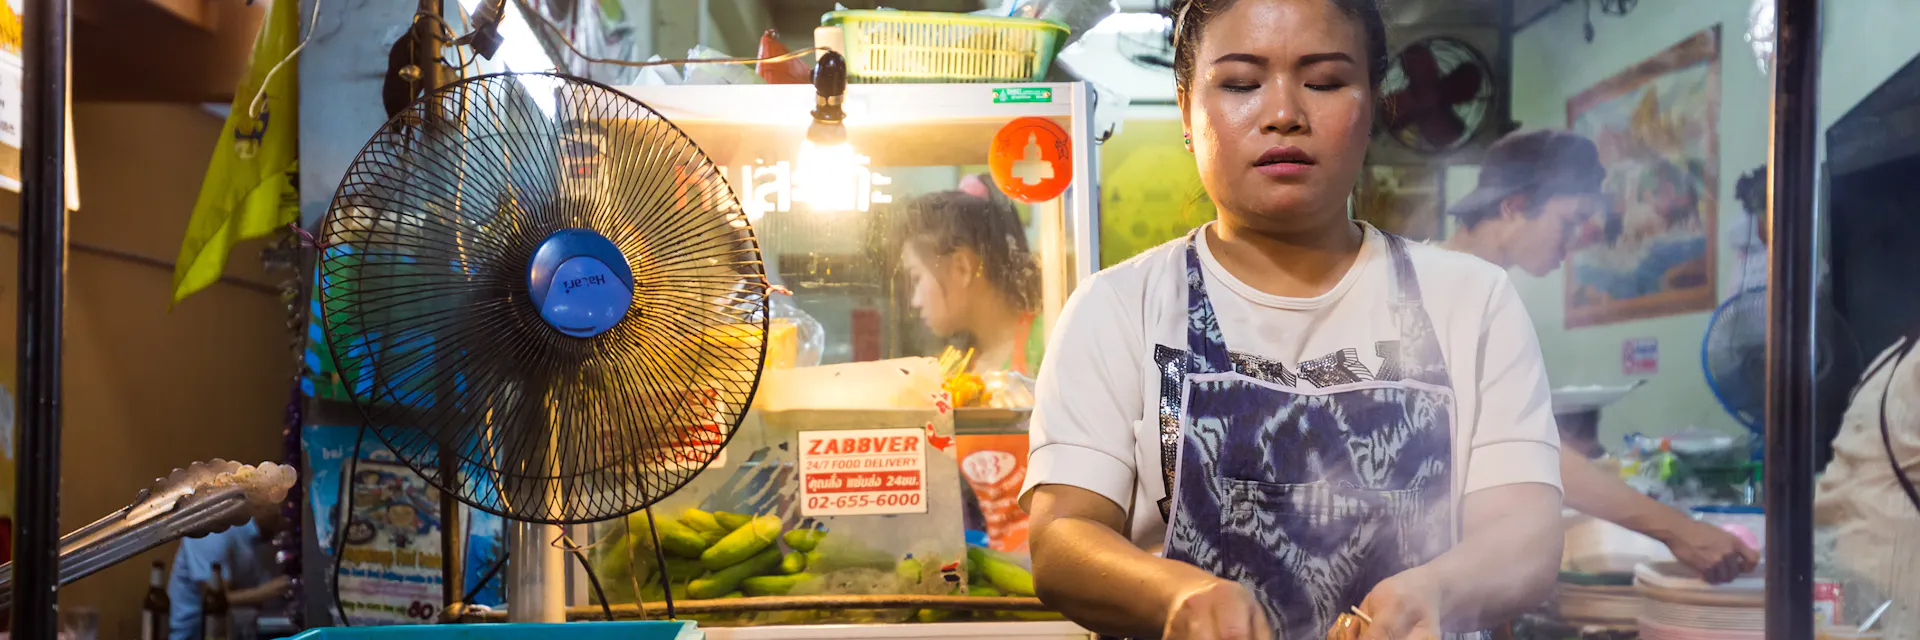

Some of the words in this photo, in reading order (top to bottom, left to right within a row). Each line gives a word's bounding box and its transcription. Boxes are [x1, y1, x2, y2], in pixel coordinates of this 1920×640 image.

[806, 435, 919, 456] ZABBVER
[806, 460, 829, 470] 24/7
[831, 458, 861, 469] FOOD
[864, 457, 918, 468] DELIVERY
[808, 493, 920, 509] 02-655-6000
[407, 600, 434, 620] 80
